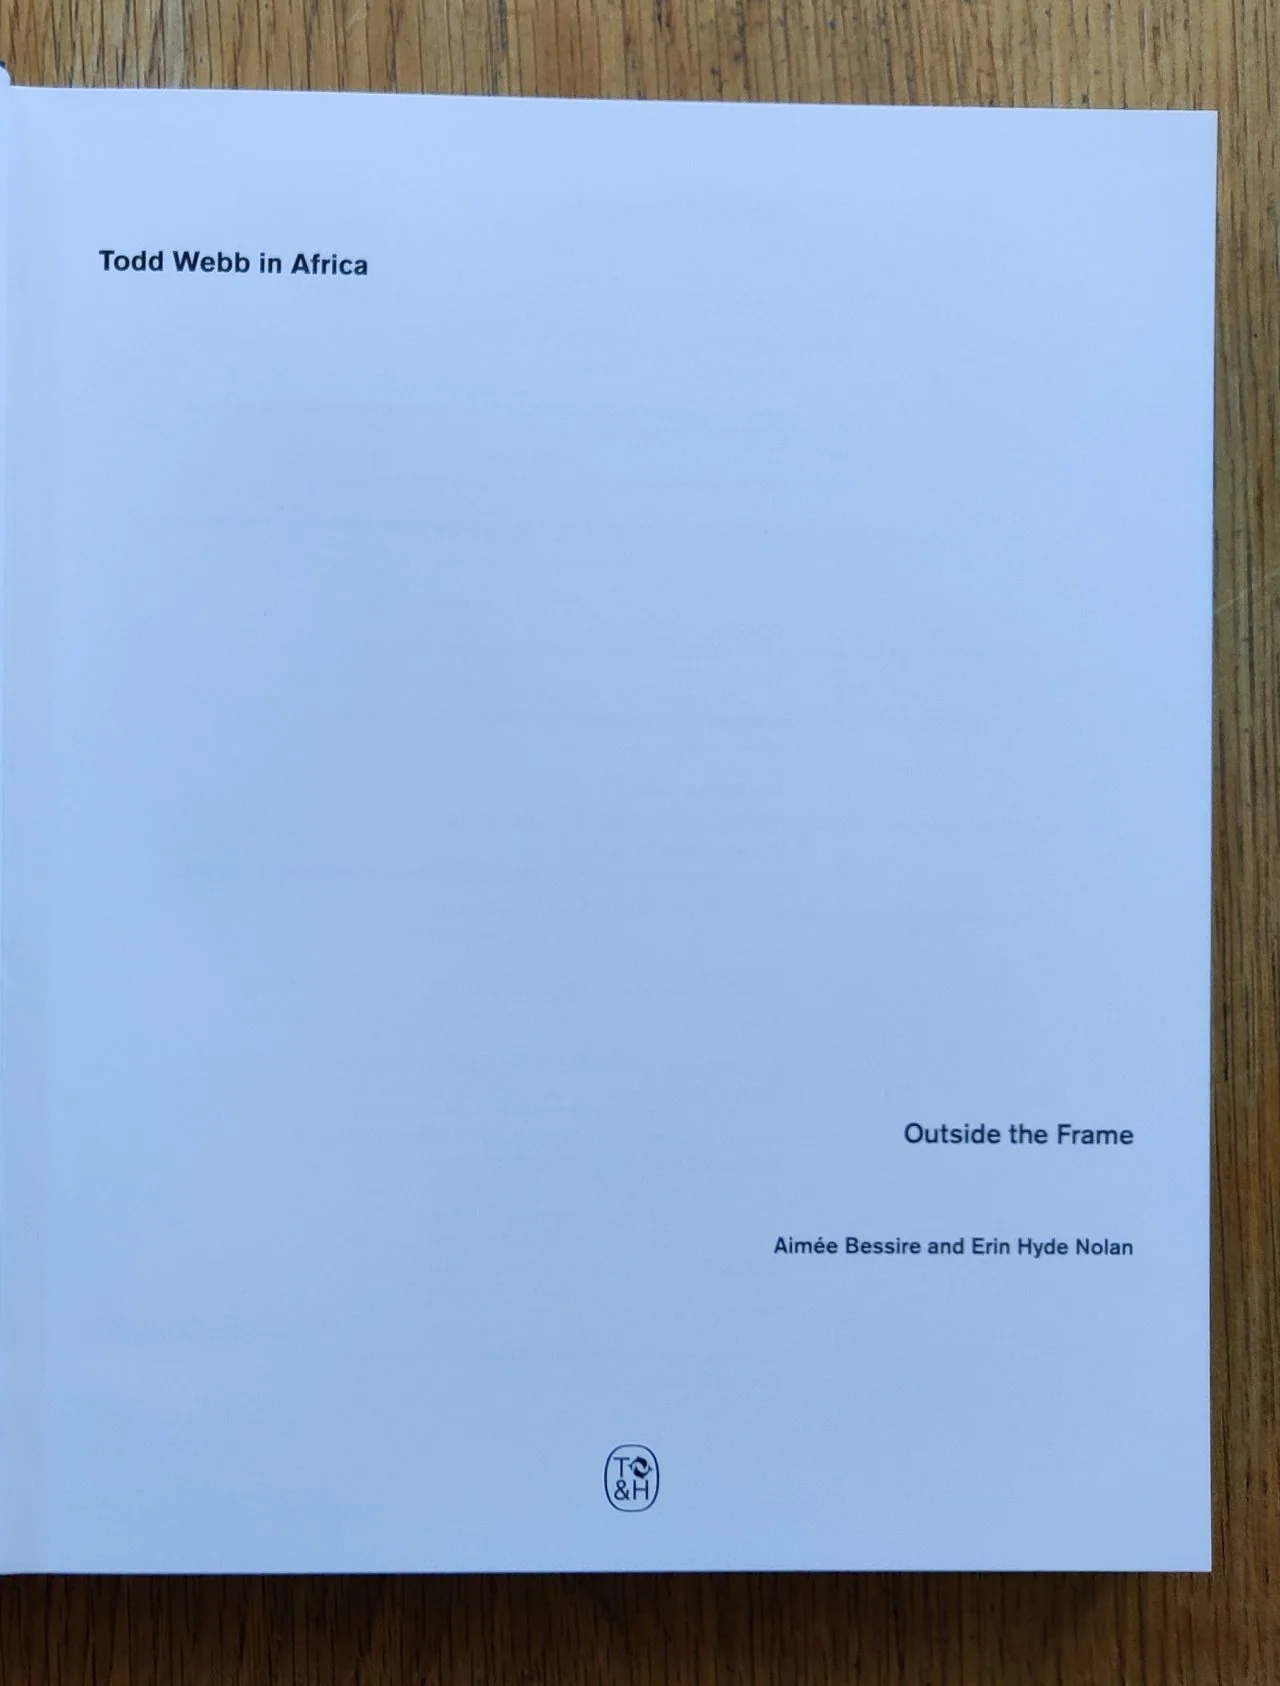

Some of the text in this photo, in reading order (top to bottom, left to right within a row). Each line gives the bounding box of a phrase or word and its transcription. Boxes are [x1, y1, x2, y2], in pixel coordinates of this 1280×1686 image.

[98, 249, 369, 277] Todd Webb in Africa
[903, 1121, 1135, 1146] Outside the Frame
[773, 1236, 1134, 1260] Aimée Bessire and Erin Hyde Nolan
